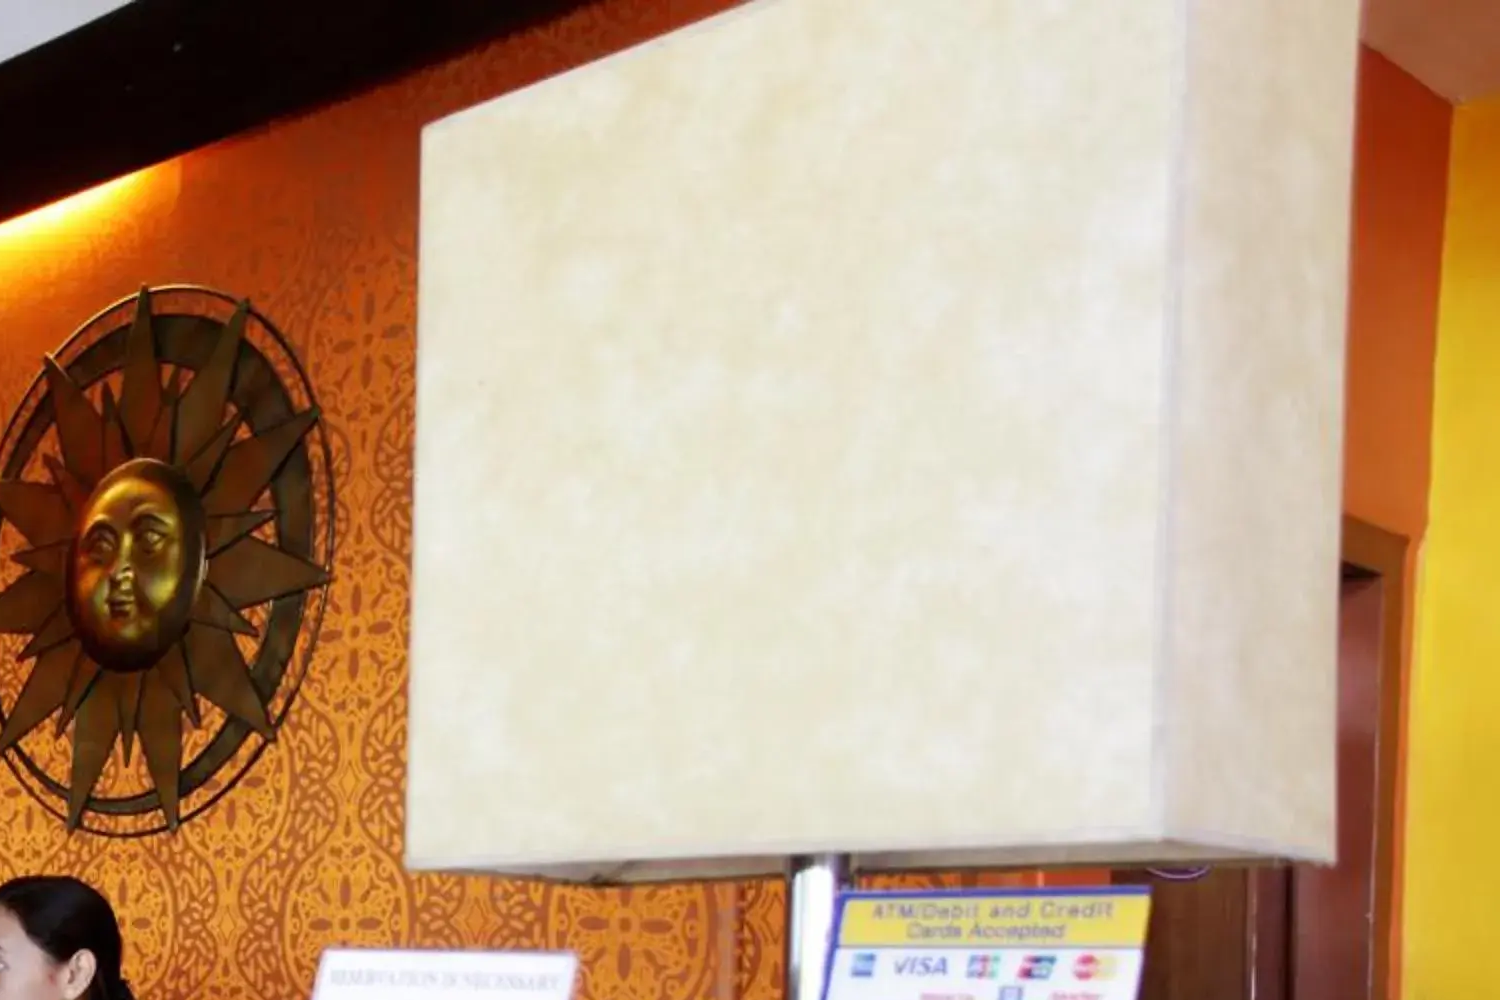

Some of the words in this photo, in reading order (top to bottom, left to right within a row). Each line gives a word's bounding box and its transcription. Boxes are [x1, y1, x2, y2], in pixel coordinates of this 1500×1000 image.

[989, 902, 1031, 919] and
[1040, 900, 1115, 918] Credit
[907, 923, 962, 939] Cards
[968, 923, 1067, 942] Accepted
[893, 955, 949, 976] VISA
